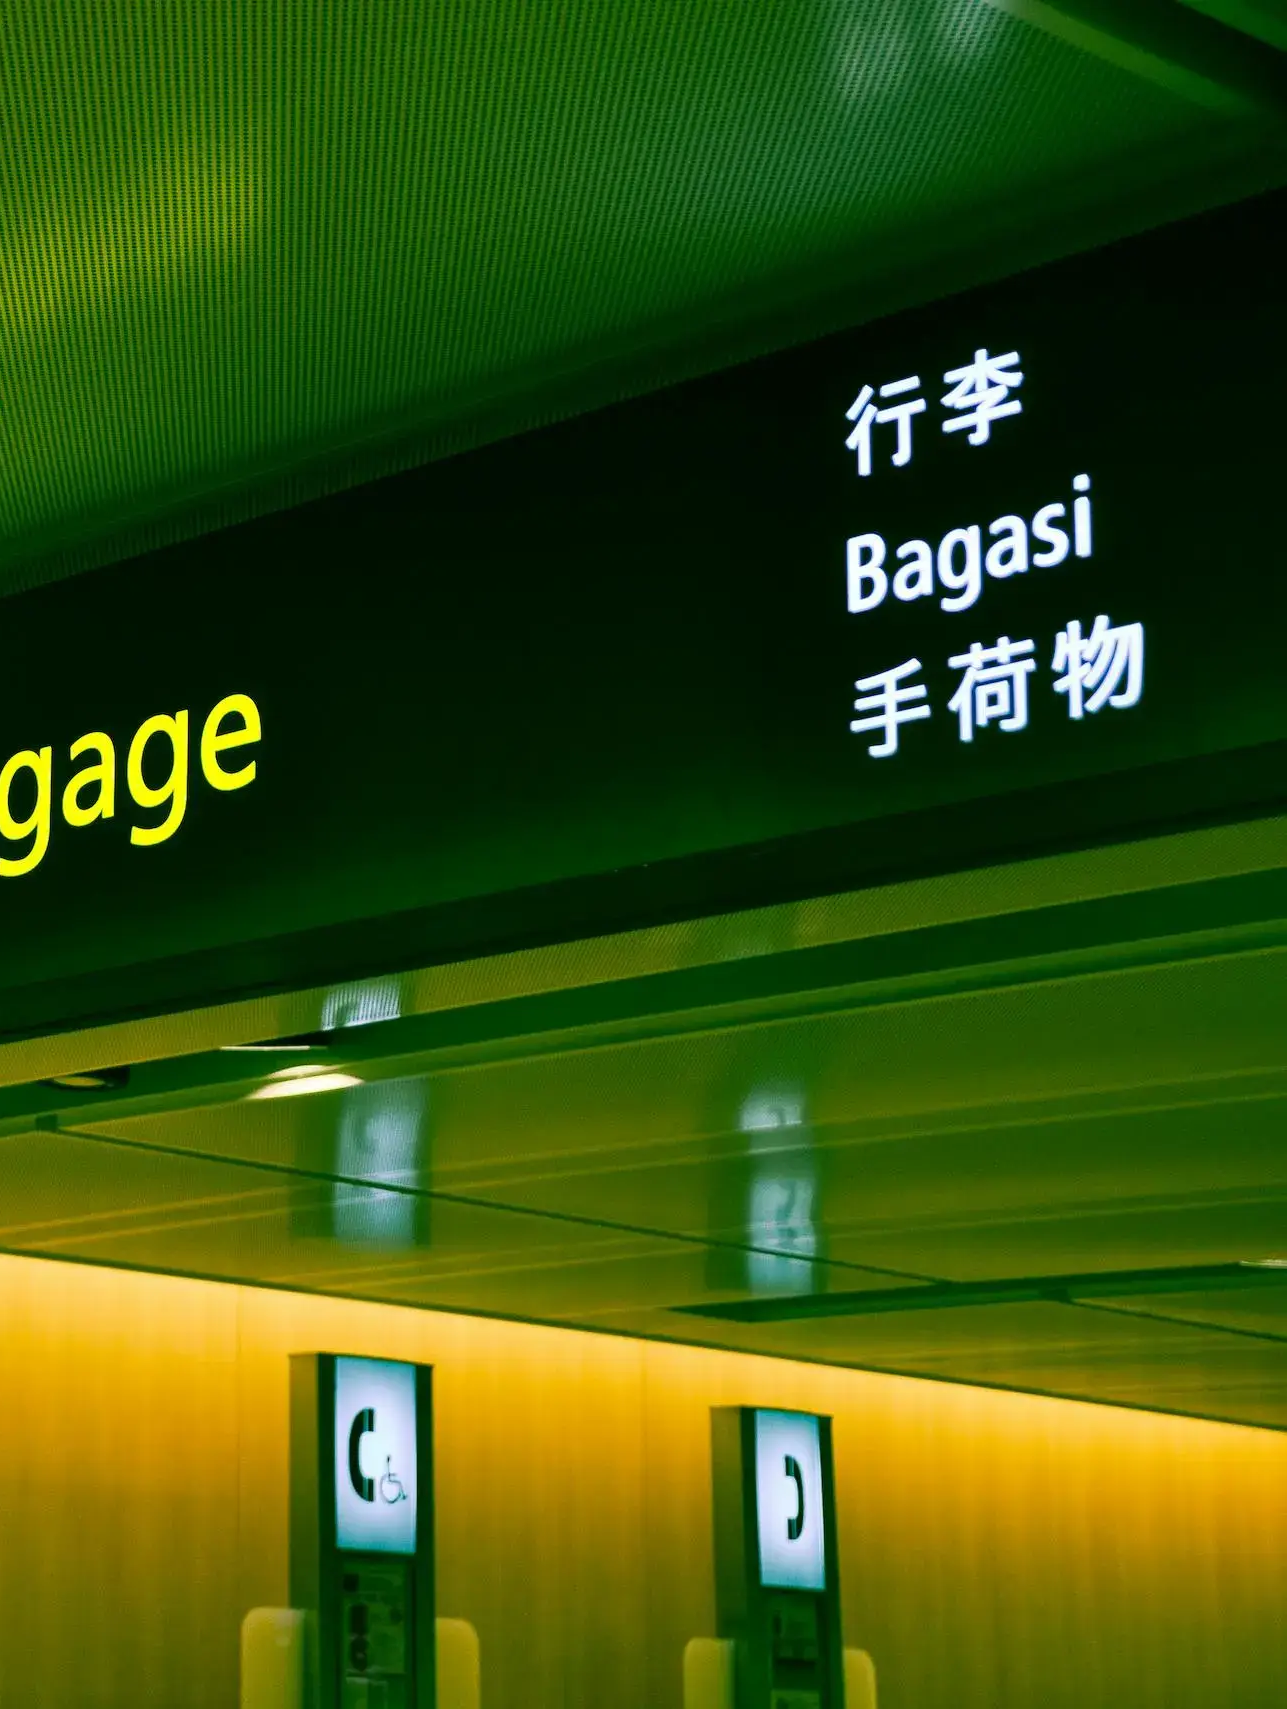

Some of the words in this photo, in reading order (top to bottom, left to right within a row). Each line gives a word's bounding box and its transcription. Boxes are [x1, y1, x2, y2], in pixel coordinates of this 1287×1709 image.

[844, 347, 1025, 478] 行李
[845, 473, 1093, 615] Bagasi
[848, 614, 1146, 759] 手荷物
